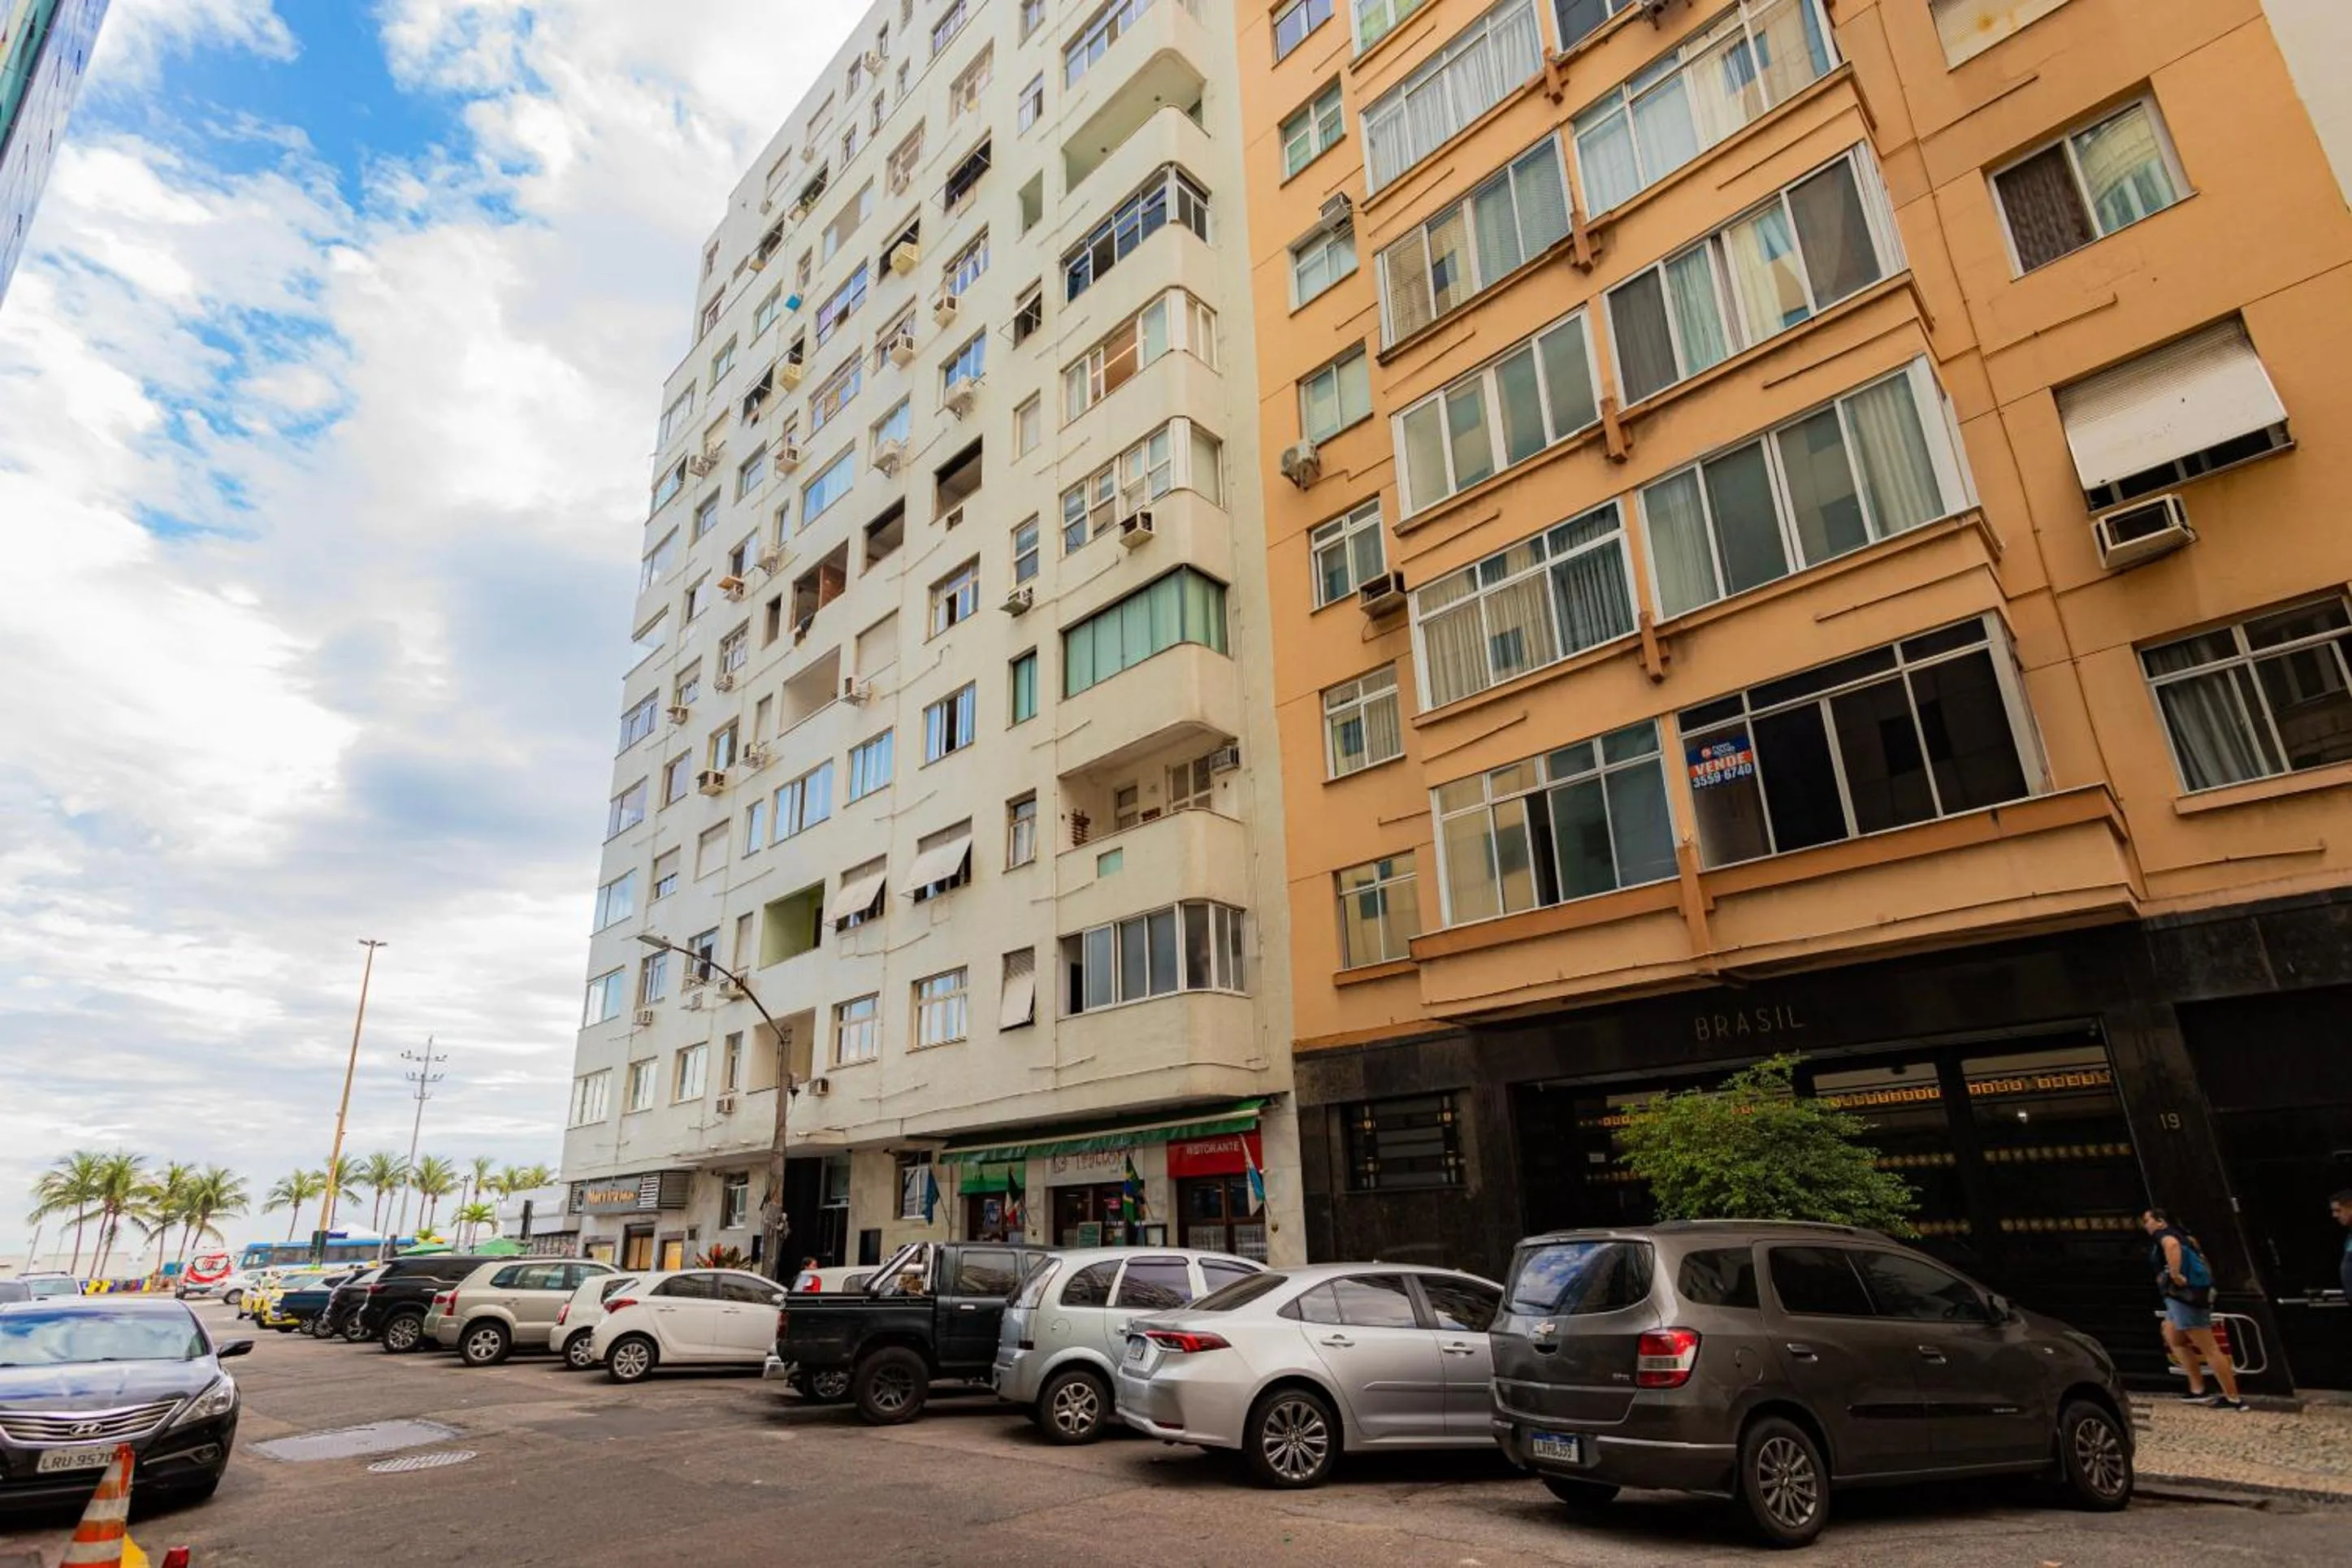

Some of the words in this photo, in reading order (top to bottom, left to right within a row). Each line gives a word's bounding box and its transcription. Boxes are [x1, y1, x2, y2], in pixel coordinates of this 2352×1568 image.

[1695, 752, 1746, 776] VENDE
[1695, 1005, 1805, 1041] BRASIL
[2160, 1113, 2181, 1129] 19
[1186, 1141, 1240, 1154] RISTORANTE
